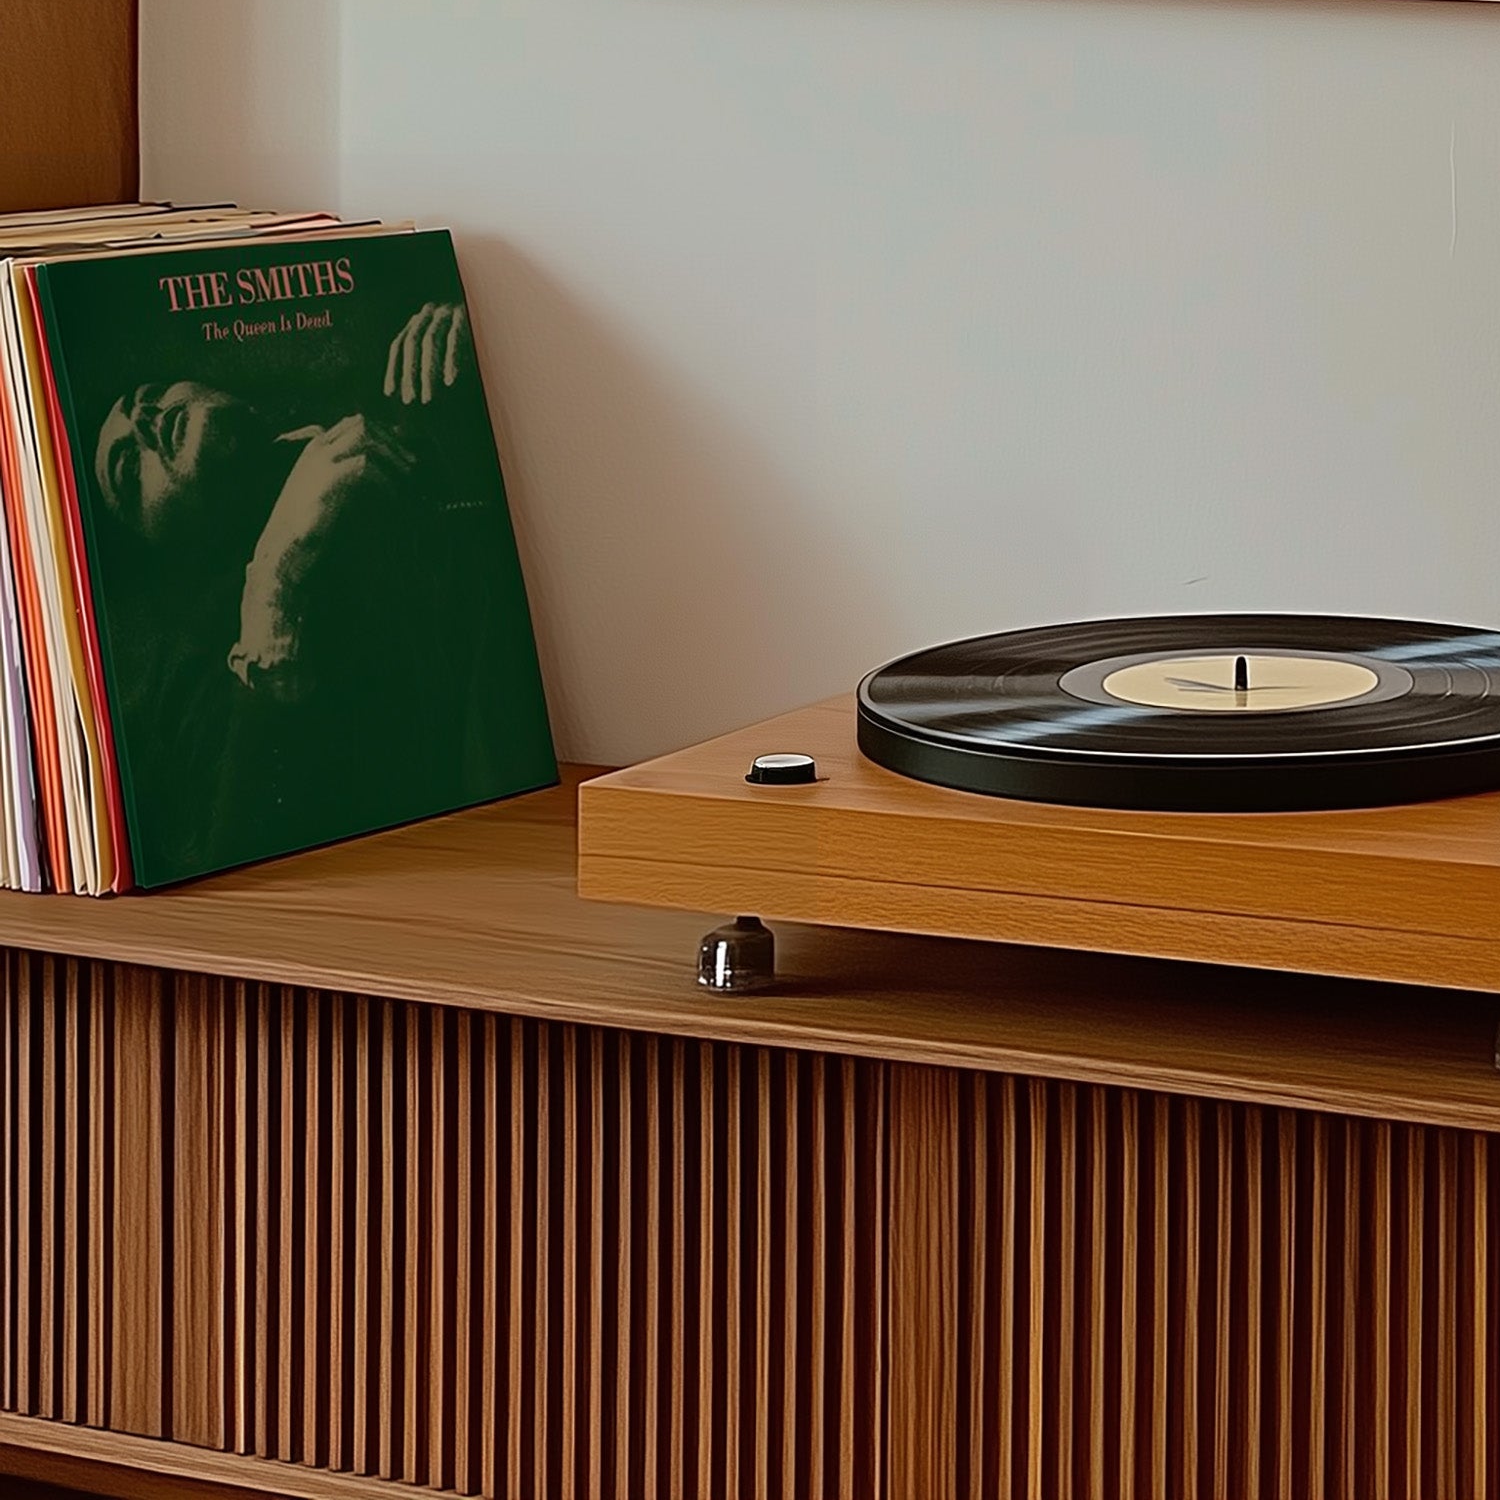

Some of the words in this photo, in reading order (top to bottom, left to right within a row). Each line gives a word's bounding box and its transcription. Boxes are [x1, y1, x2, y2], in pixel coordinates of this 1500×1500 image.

[158, 271, 234, 312] THE
[235, 257, 355, 304] SMITHS
[201, 321, 230, 341] The
[232, 319, 276, 342] Queen
[280, 313, 292, 332] Is
[296, 309, 333, 331] Dead
